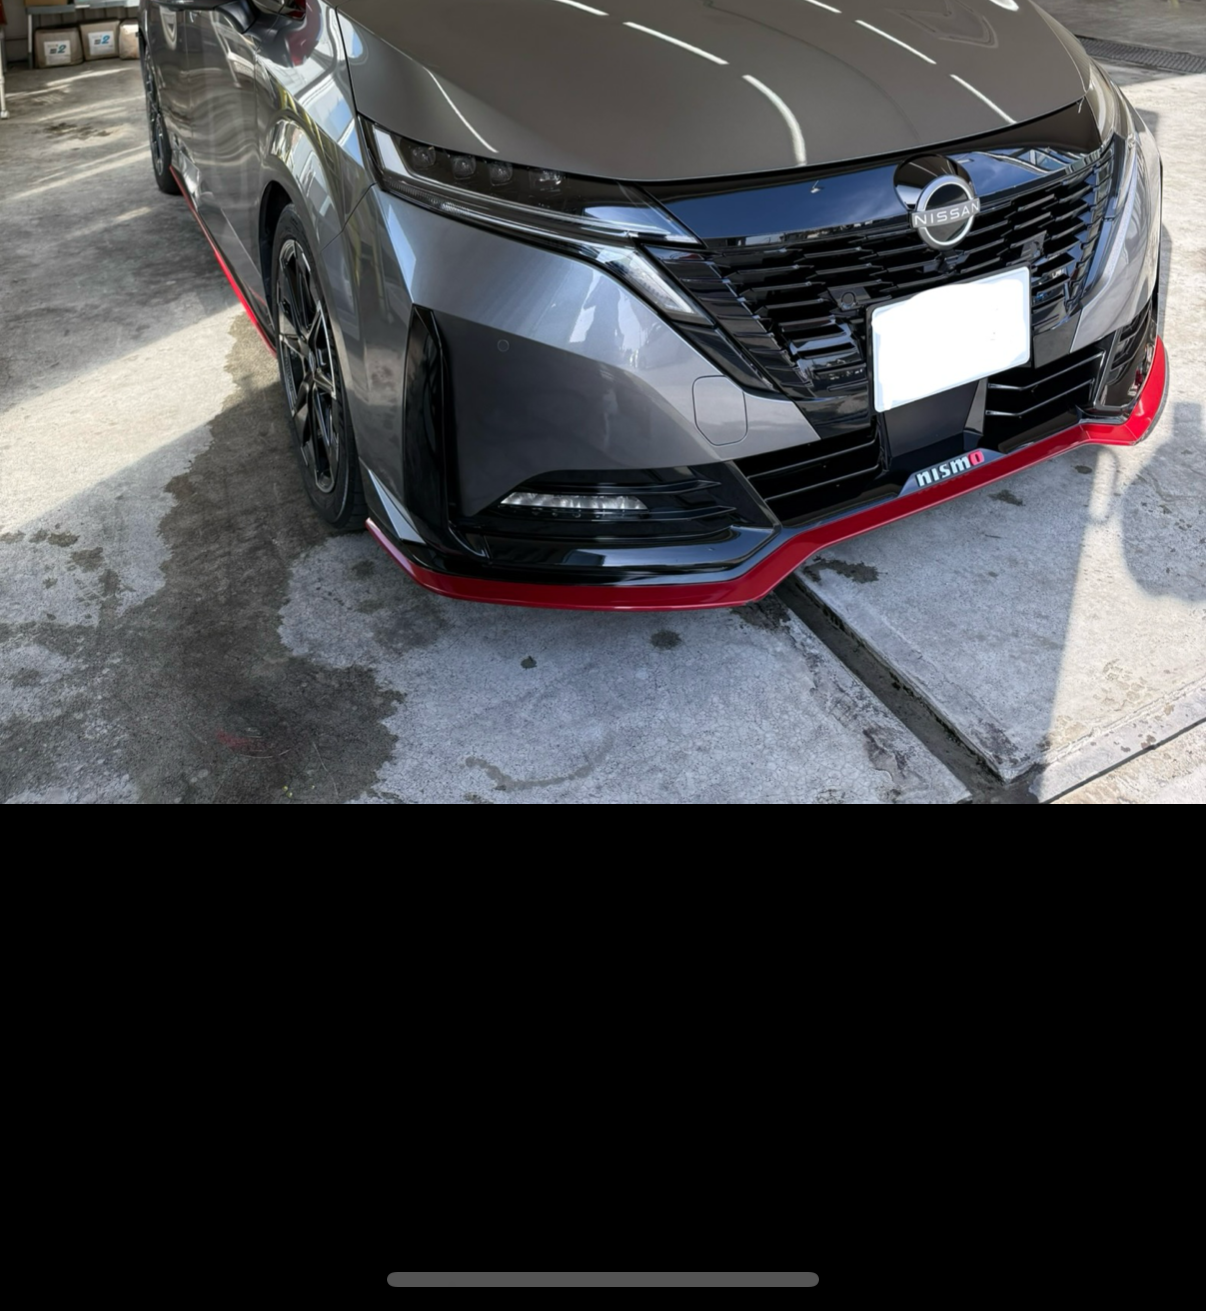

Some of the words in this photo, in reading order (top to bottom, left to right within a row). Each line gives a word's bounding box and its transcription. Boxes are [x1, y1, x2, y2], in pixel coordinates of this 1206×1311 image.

[102, 34, 110, 44] 2
[57, 44, 66, 54] 2
[914, 200, 979, 226] NISSAN
[916, 450, 985, 487] nismo
